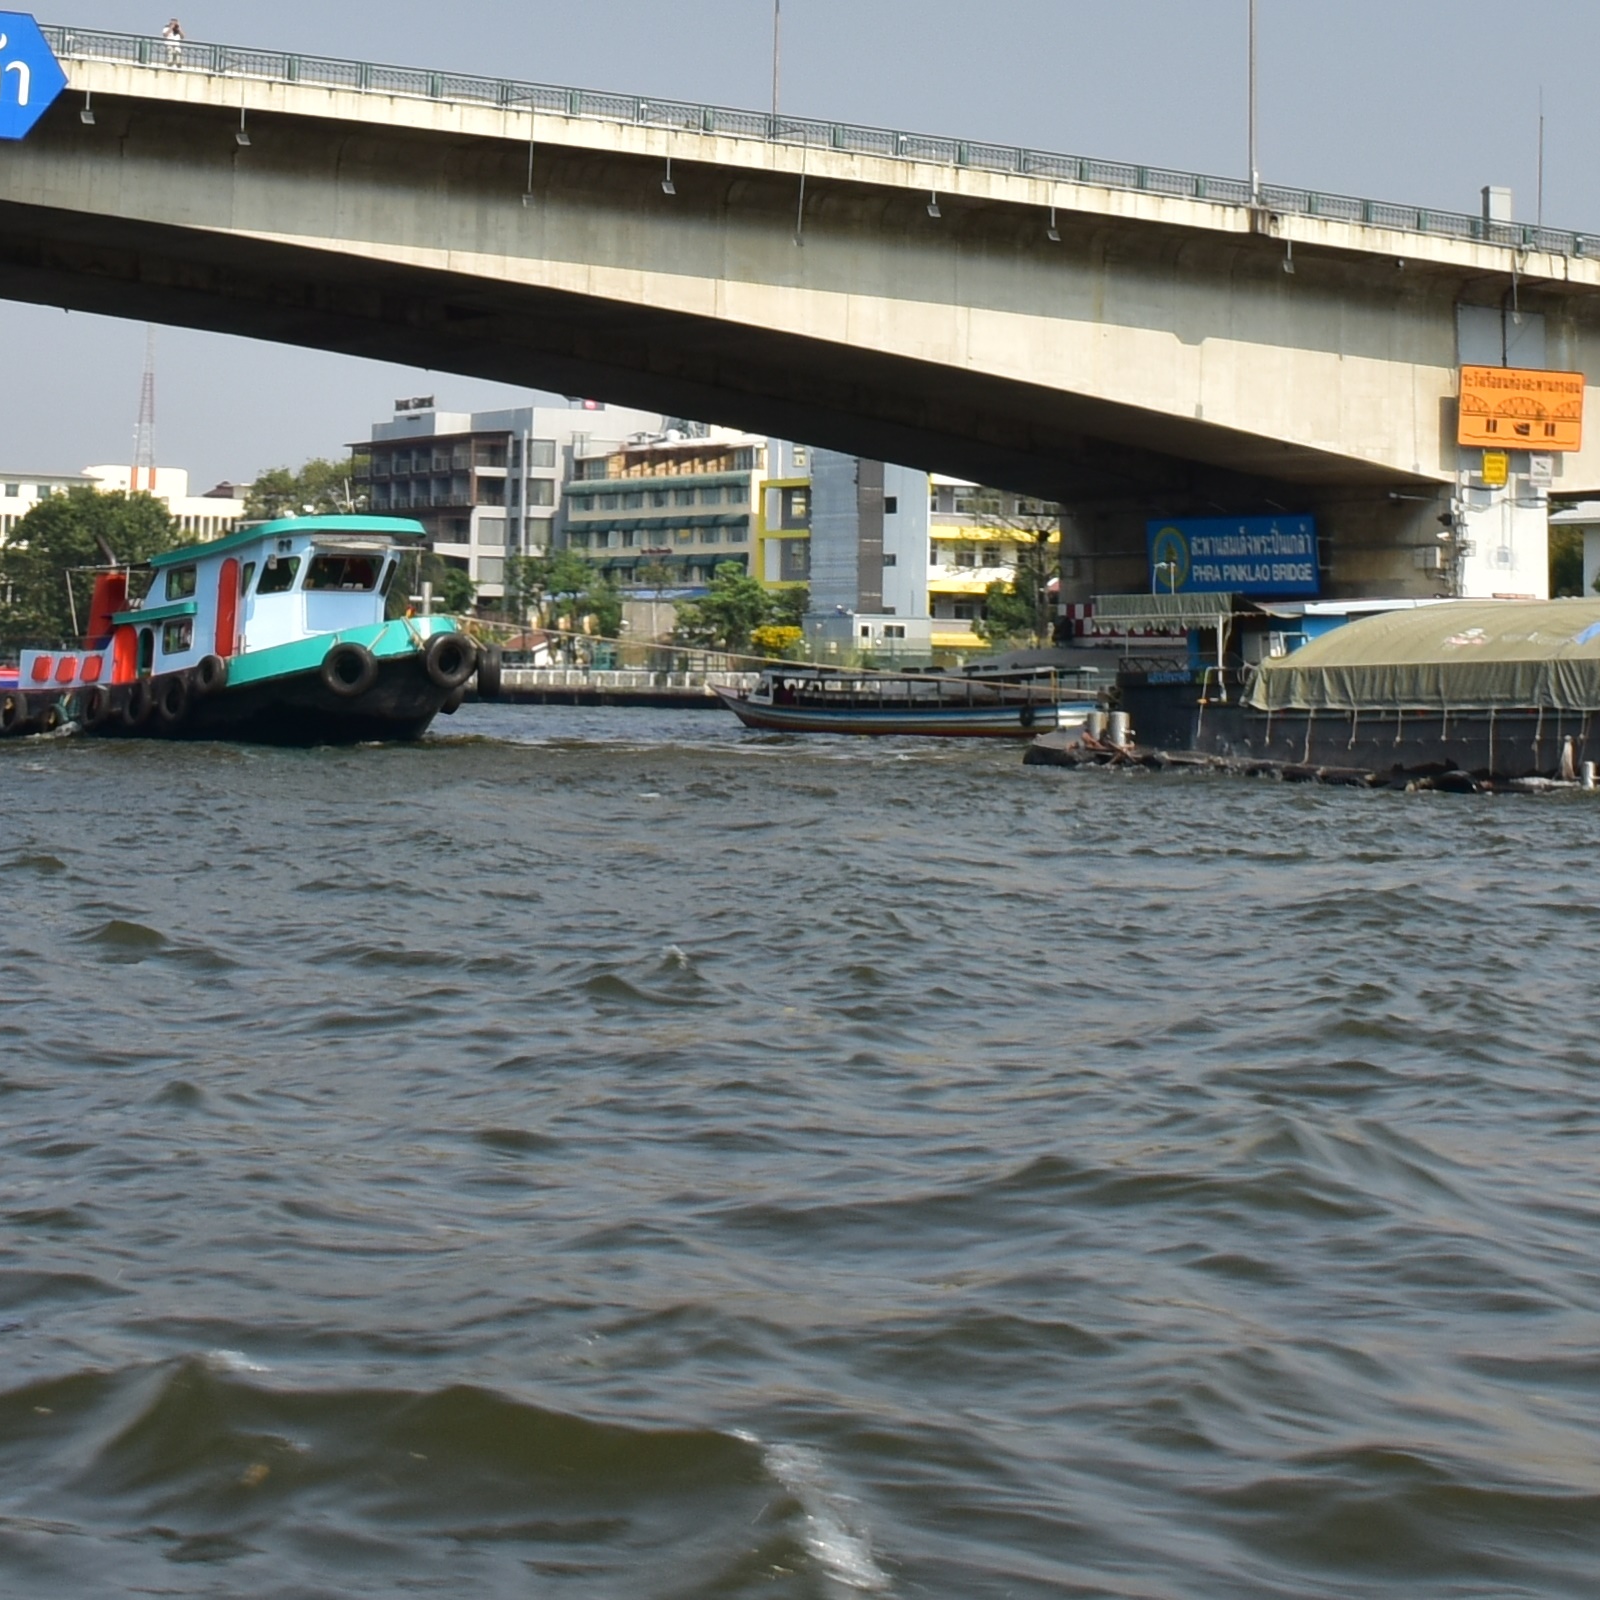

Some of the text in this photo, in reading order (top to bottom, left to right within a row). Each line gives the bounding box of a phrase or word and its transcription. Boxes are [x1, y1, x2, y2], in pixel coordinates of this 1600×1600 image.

[1192, 563, 1313, 582] PHRA PINKLAO BRIDGE
